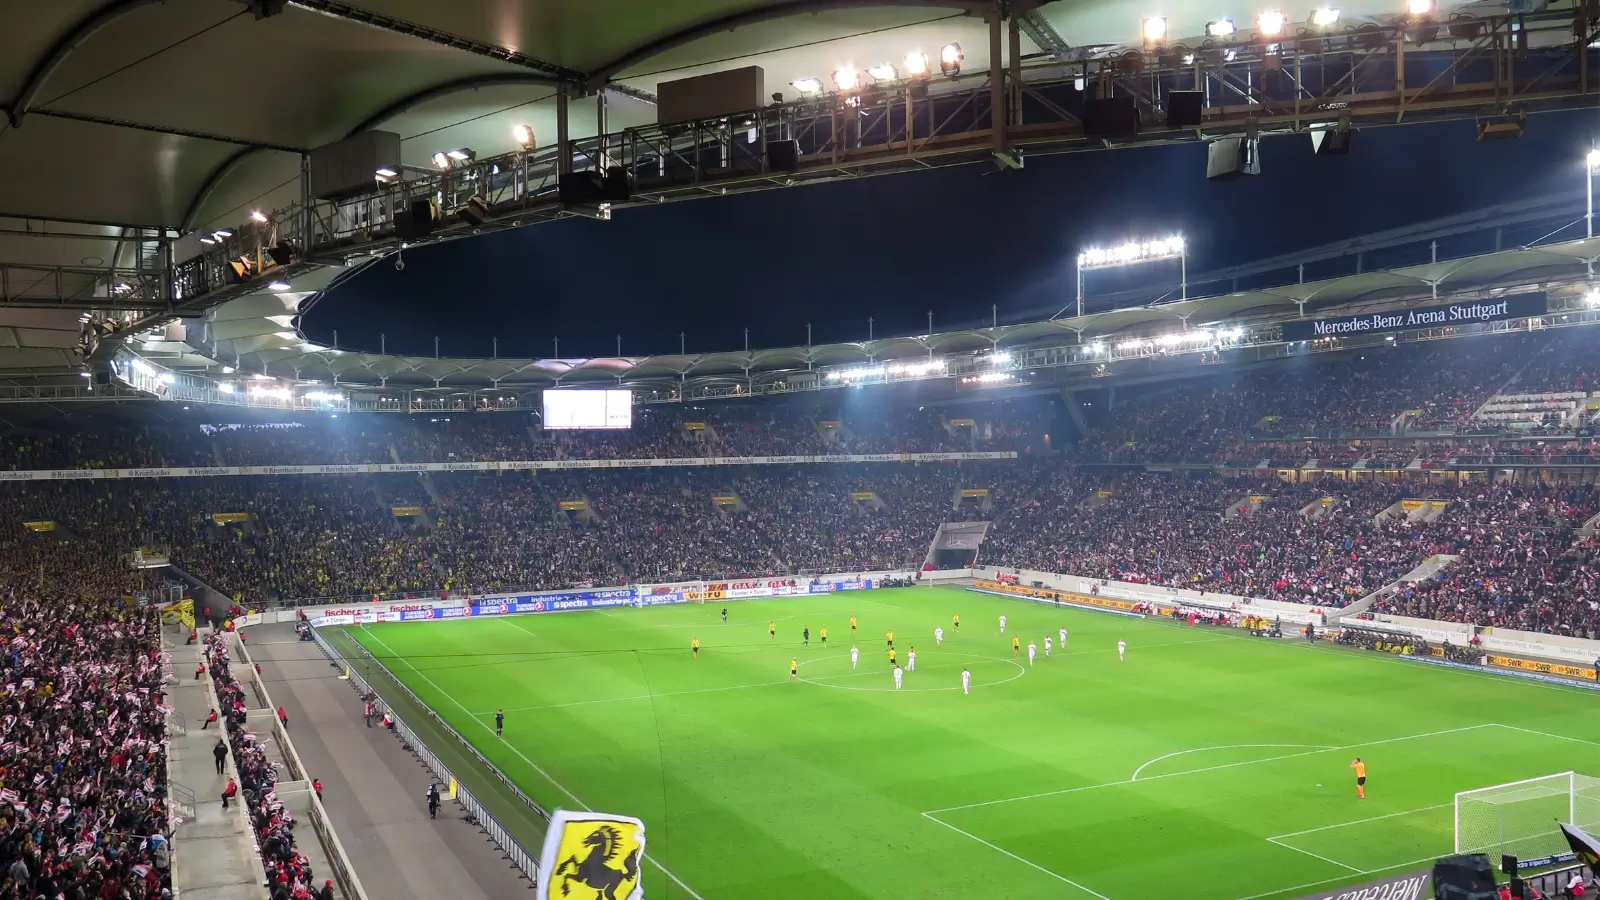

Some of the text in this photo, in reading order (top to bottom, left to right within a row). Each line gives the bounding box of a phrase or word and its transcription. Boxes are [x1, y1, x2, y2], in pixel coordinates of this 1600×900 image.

[1313, 300, 1508, 335] Mercedes-Benz Arena Stuttgart
[135, 468, 170, 477] Krombacher
[194, 467, 230, 475] Krombacher
[269, 466, 303, 474] Krombacher
[325, 465, 359, 473] Krombacher
[395, 464, 427, 472] Krombacher
[57, 471, 94, 479] Krombacher
[651, 594, 677, 603] spectra
[689, 592, 720, 600] weru
[487, 596, 518, 606] spectra
[560, 599, 588, 609] spectra
[325, 608, 355, 617] fischer
[390, 604, 419, 613] fischer
